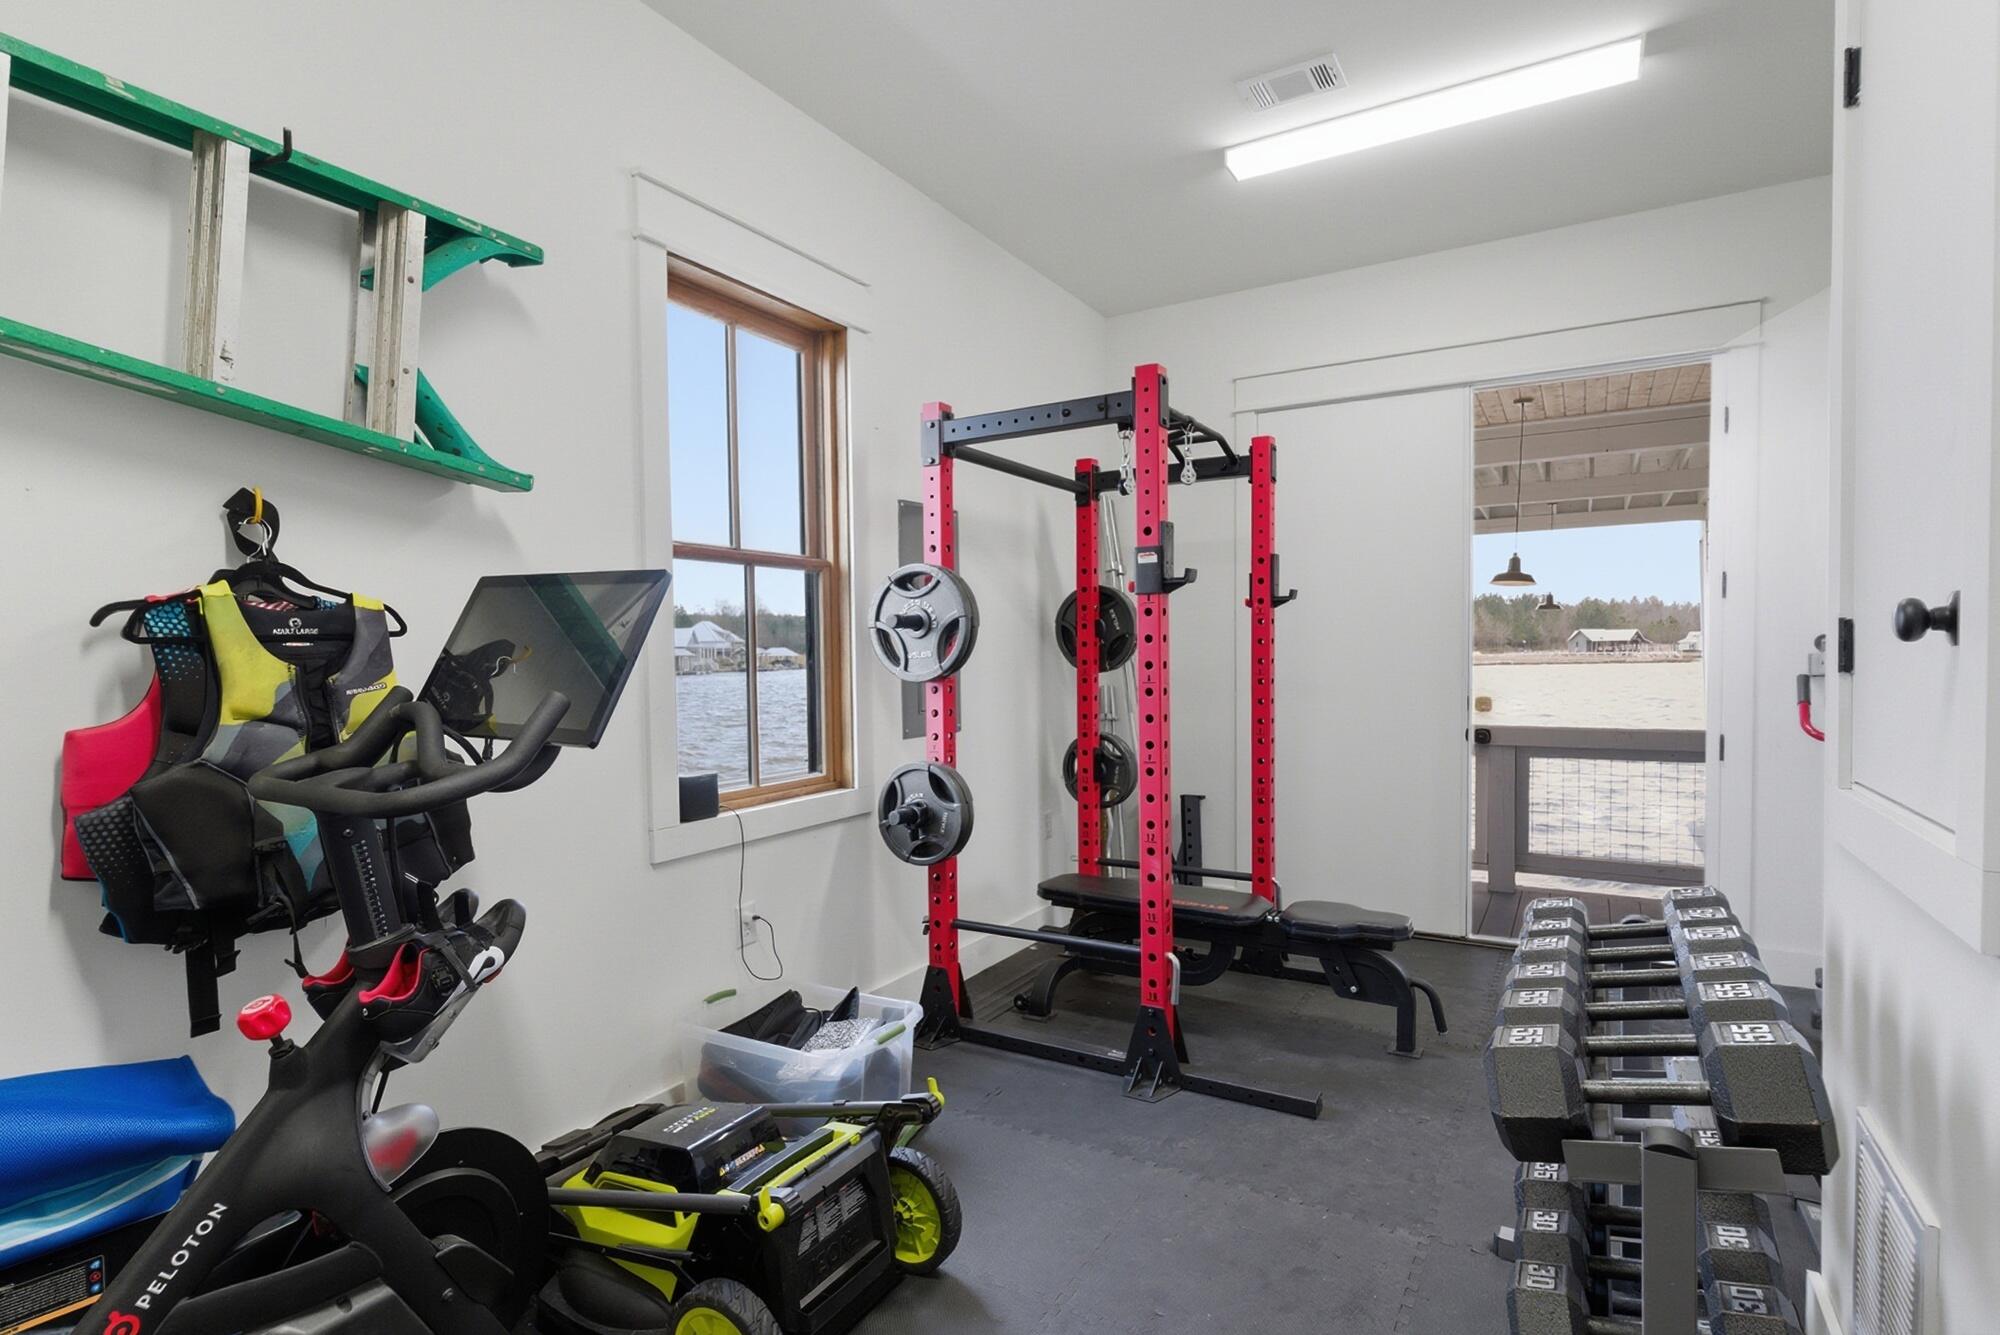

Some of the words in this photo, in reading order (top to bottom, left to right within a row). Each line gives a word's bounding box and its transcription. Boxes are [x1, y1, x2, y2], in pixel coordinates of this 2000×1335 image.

[1527, 964, 1554, 977] 50
[1702, 954, 1737, 968] 50
[1518, 990, 1550, 1006] 55
[1714, 983, 1753, 998] 55
[1508, 1027, 1544, 1045] 55
[1730, 1024, 1775, 1042] 55
[1533, 1162, 1560, 1182] 35
[1532, 1211, 1559, 1232] 30
[1716, 1225, 1750, 1250] 30
[134, 1202, 228, 1310] PELOTON
[1526, 1264, 1556, 1290] 30
[1729, 1286, 1768, 1315] 30
